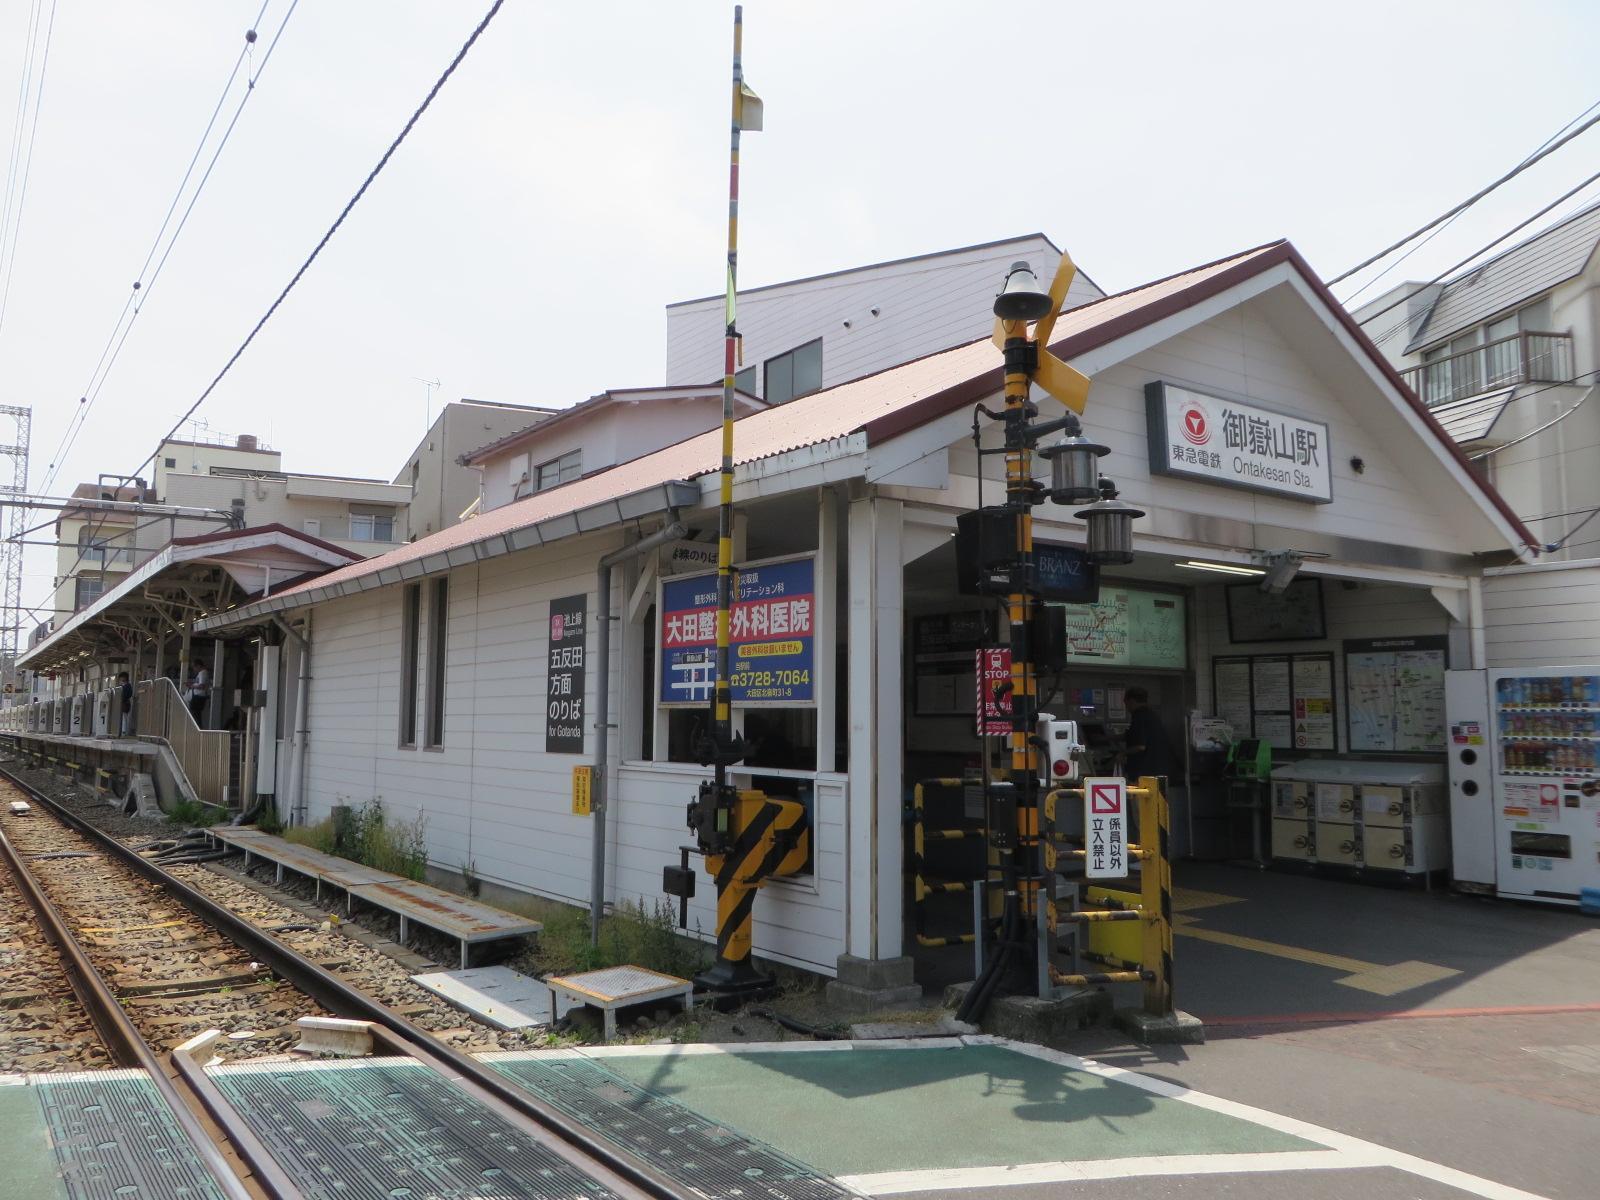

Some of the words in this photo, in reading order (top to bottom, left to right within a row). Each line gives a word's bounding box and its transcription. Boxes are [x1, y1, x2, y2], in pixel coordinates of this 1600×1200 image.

[1221, 408, 1319, 467] 御嶽山駅
[1172, 444, 1221, 469] 東急電鉄
[1233, 456, 1290, 485] Ontakesan
[1294, 469, 1313, 488] Sta.
[1040, 556, 1080, 576] BRANZ
[666, 599, 810, 643] 大田整外科医院
[550, 646, 583, 669] 五反田
[550, 673, 572, 696] 方面
[984, 670, 1009, 679] STOP
[55, 717, 61, 725] 3
[73, 716, 80, 725] 2
[101, 715, 105, 725] 1
[549, 699, 582, 720] のりば
[557, 724, 581, 737] Gotanda
[1092, 818, 1105, 870] 立入禁止
[1109, 817, 1121, 870] 係員以外
